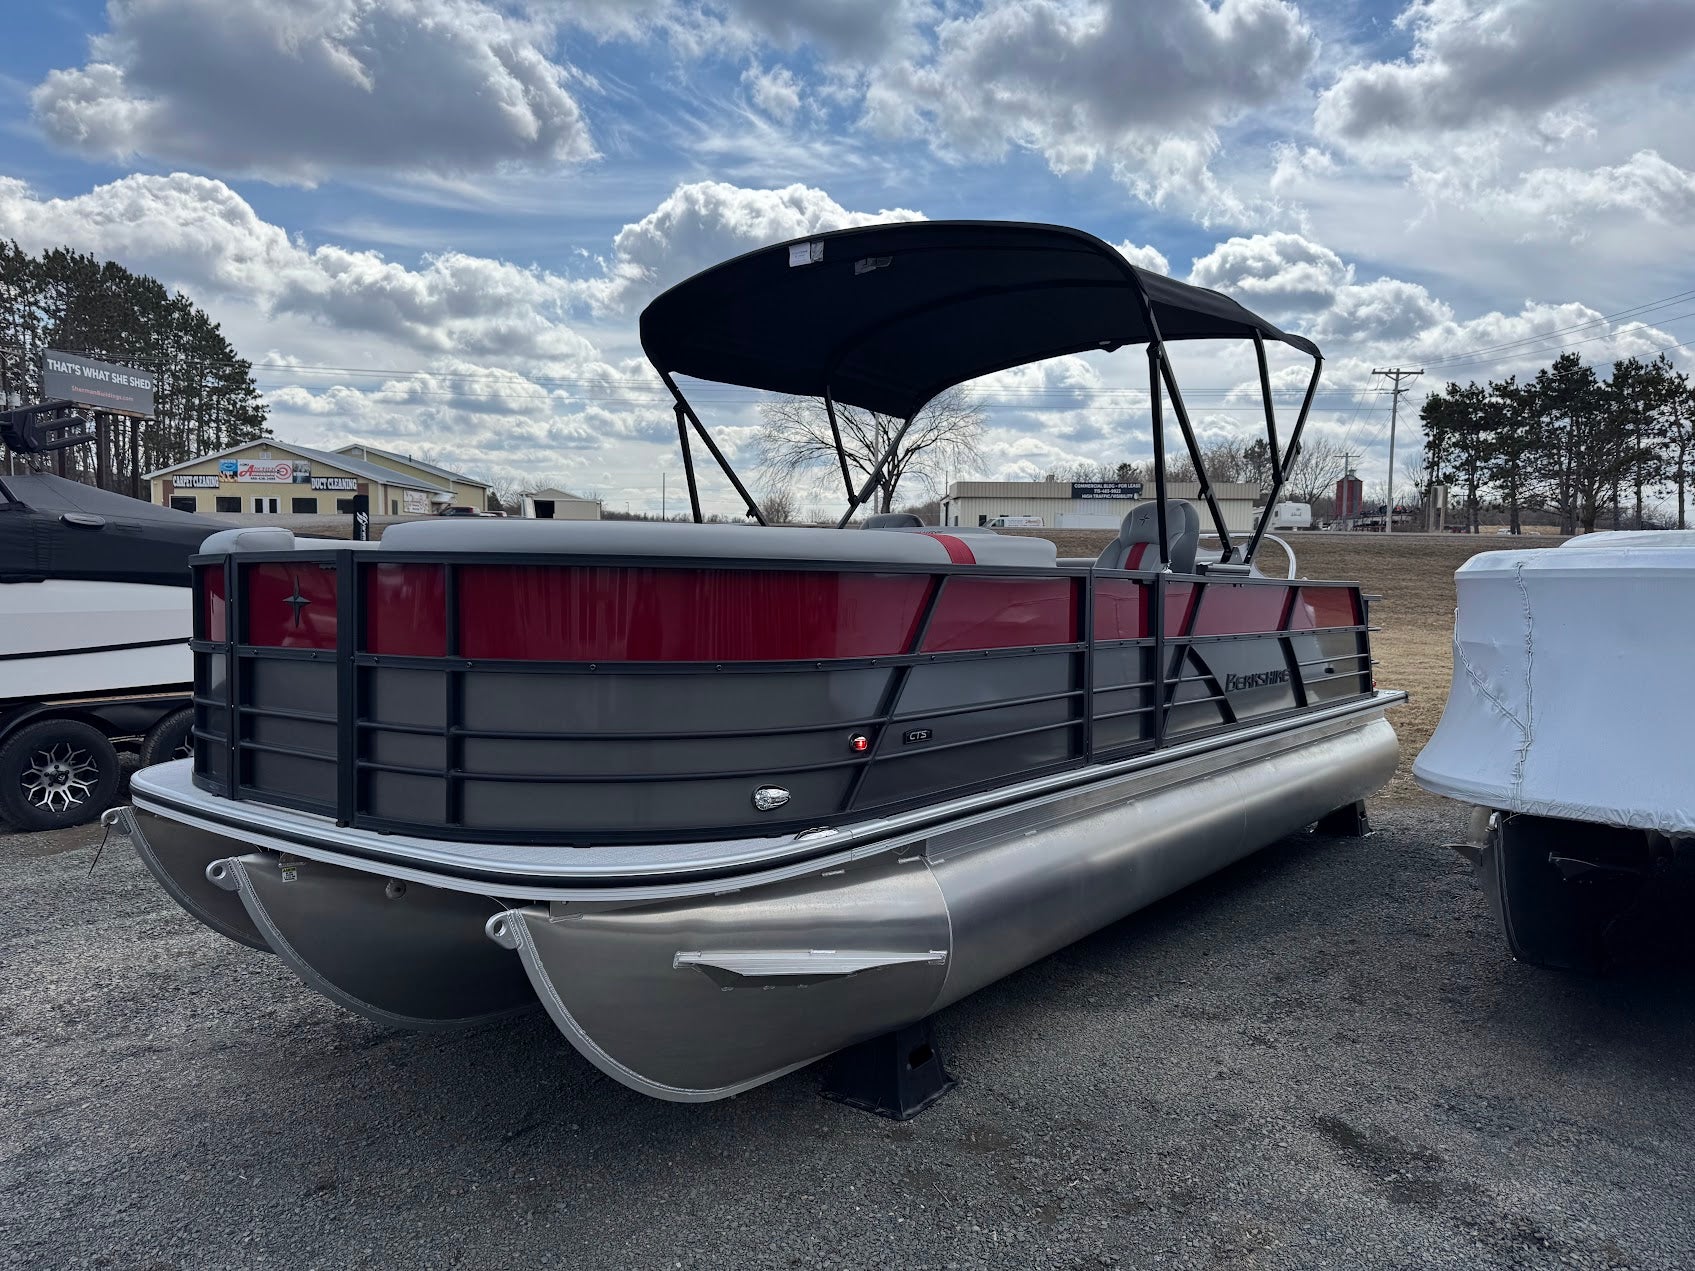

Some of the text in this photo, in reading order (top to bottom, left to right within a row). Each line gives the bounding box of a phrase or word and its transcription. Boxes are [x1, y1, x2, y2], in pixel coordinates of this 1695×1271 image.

[46, 359, 151, 390] THAT'S WHAT SHE SHED
[173, 476, 218, 488] CARPET CLEANING
[311, 478, 357, 489] DUCT CLEANING
[1225, 668, 1290, 693] BERKSHIRE
[909, 730, 927, 740] CTS
